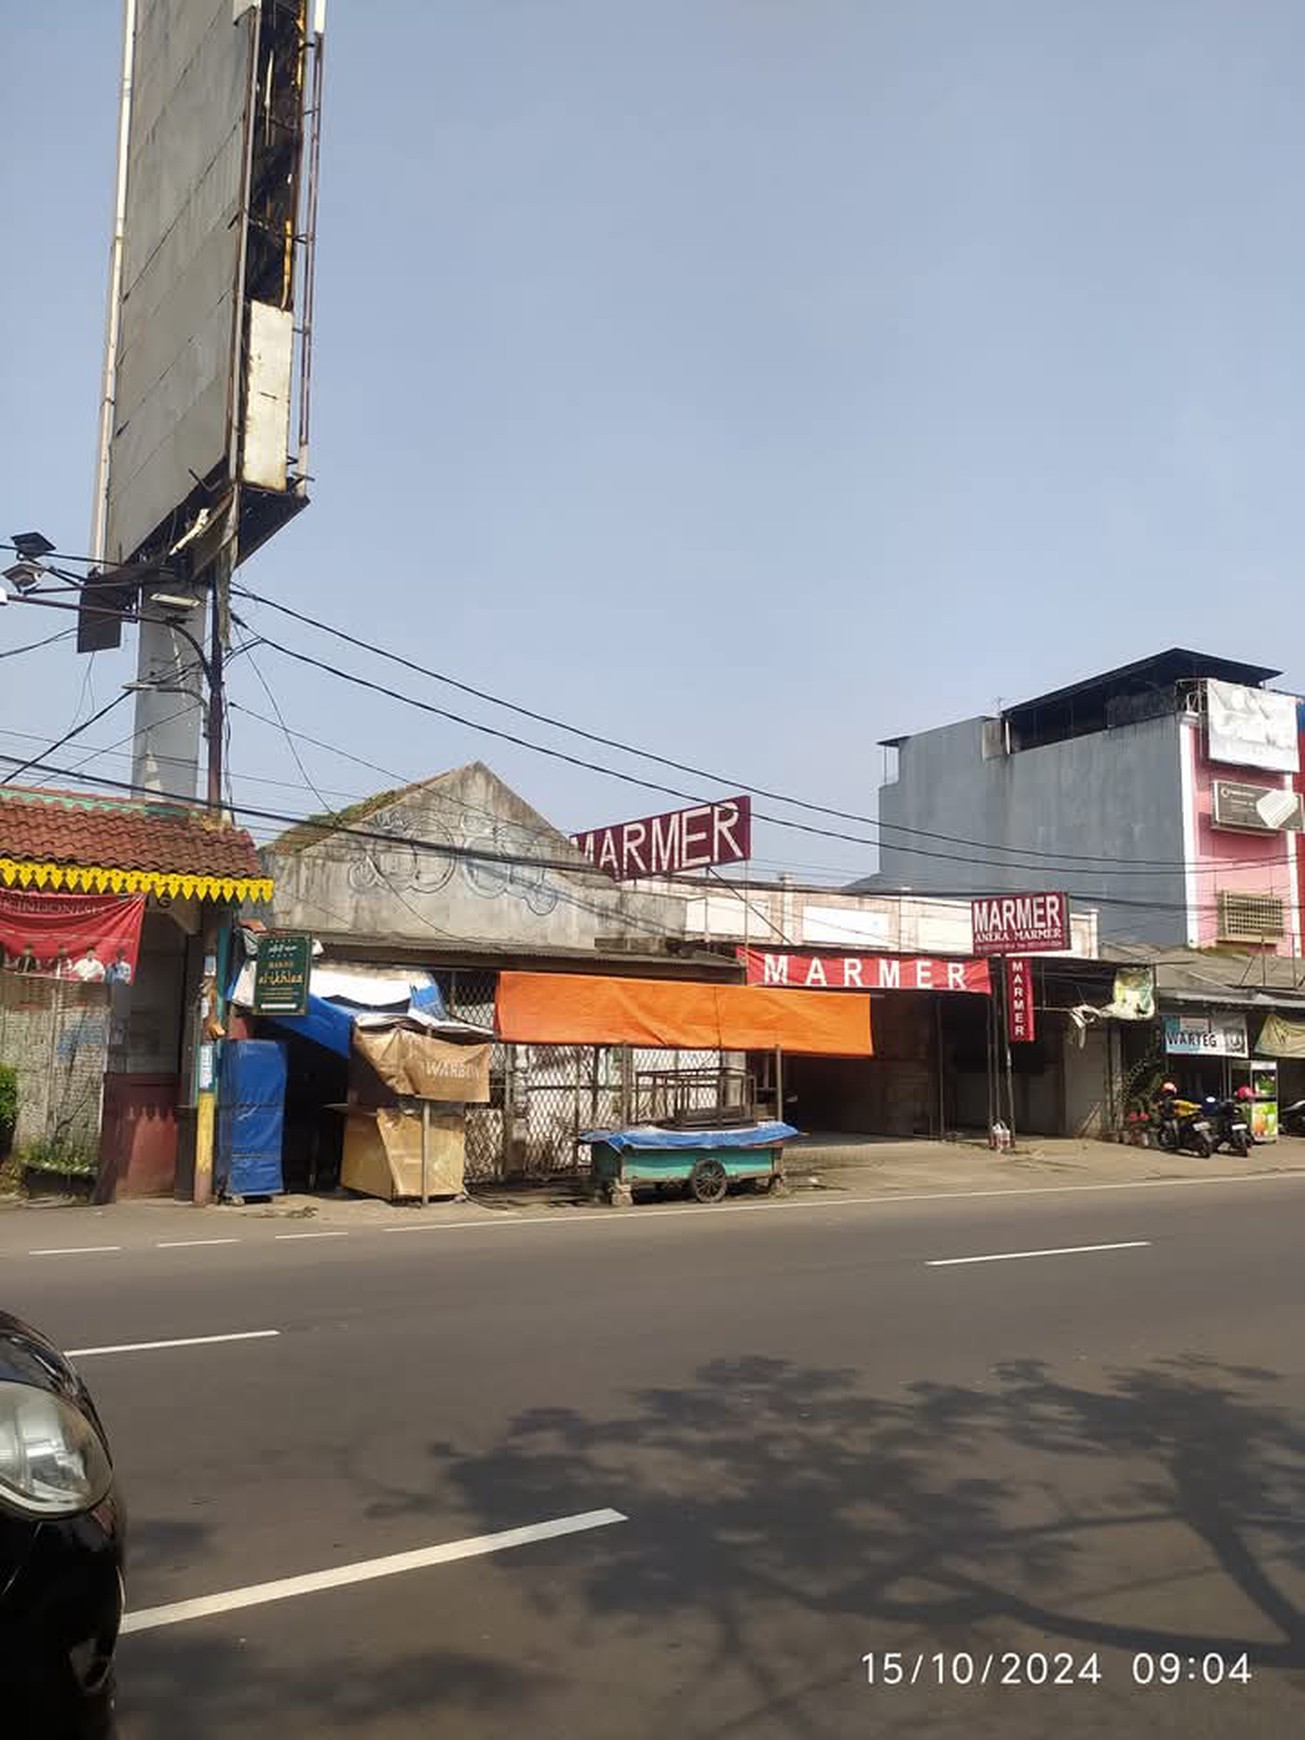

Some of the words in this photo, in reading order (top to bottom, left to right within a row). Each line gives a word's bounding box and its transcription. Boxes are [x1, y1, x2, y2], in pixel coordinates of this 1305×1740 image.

[572, 801, 744, 879] MARMER
[973, 894, 1062, 932] MARMER
[1014, 928, 1062, 941] MARMER
[763, 953, 968, 991] MARMER
[1012, 960, 1025, 1036] MARMER
